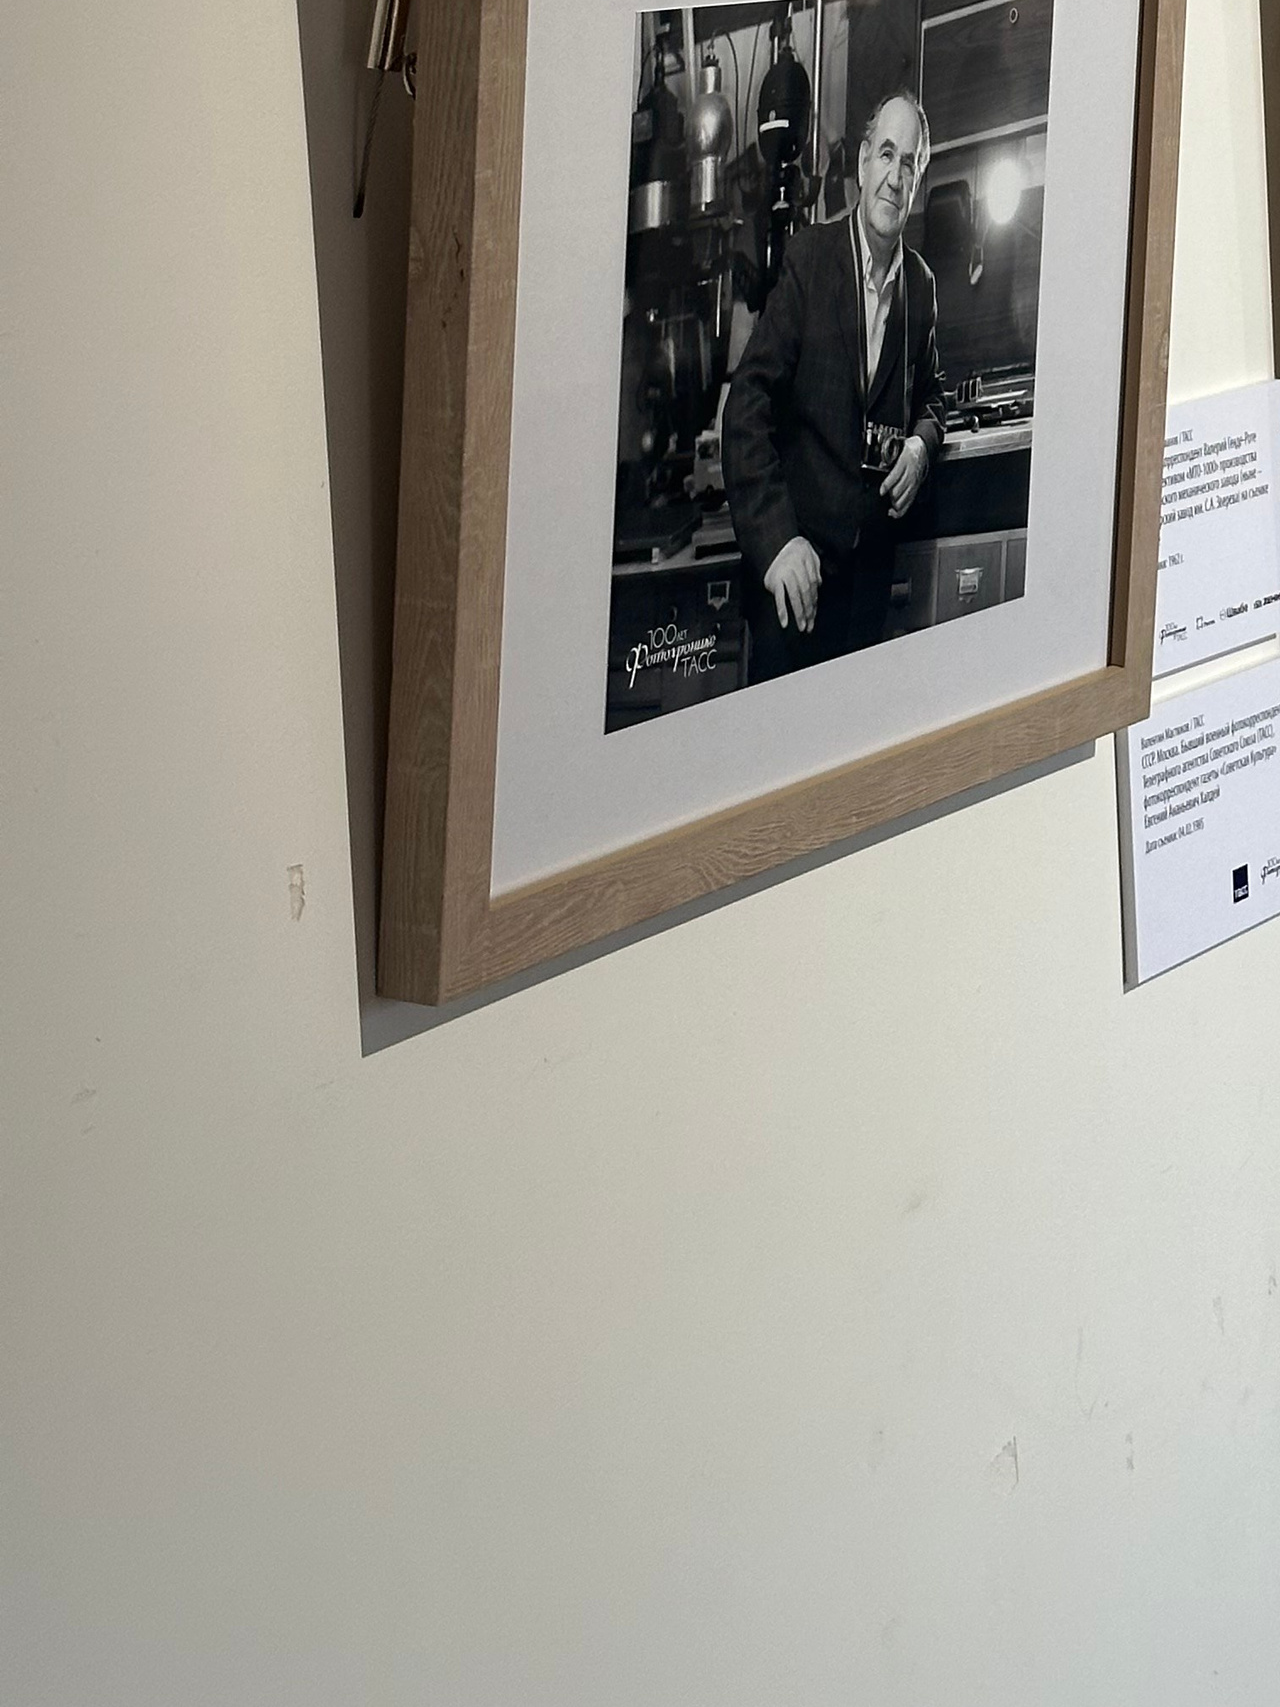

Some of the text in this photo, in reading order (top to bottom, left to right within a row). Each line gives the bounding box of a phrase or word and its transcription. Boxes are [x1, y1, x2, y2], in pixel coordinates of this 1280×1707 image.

[1178, 478, 1220, 501] механического
[1220, 473, 1239, 491] завода
[647, 623, 677, 650] 100
[680, 649, 718, 678] ТАСС
[1205, 726, 1230, 744] военный
[1209, 741, 1239, 762] Советского
[1143, 778, 1200, 812] фотокорреспондент
[1144, 808, 1168, 830] Евгений
